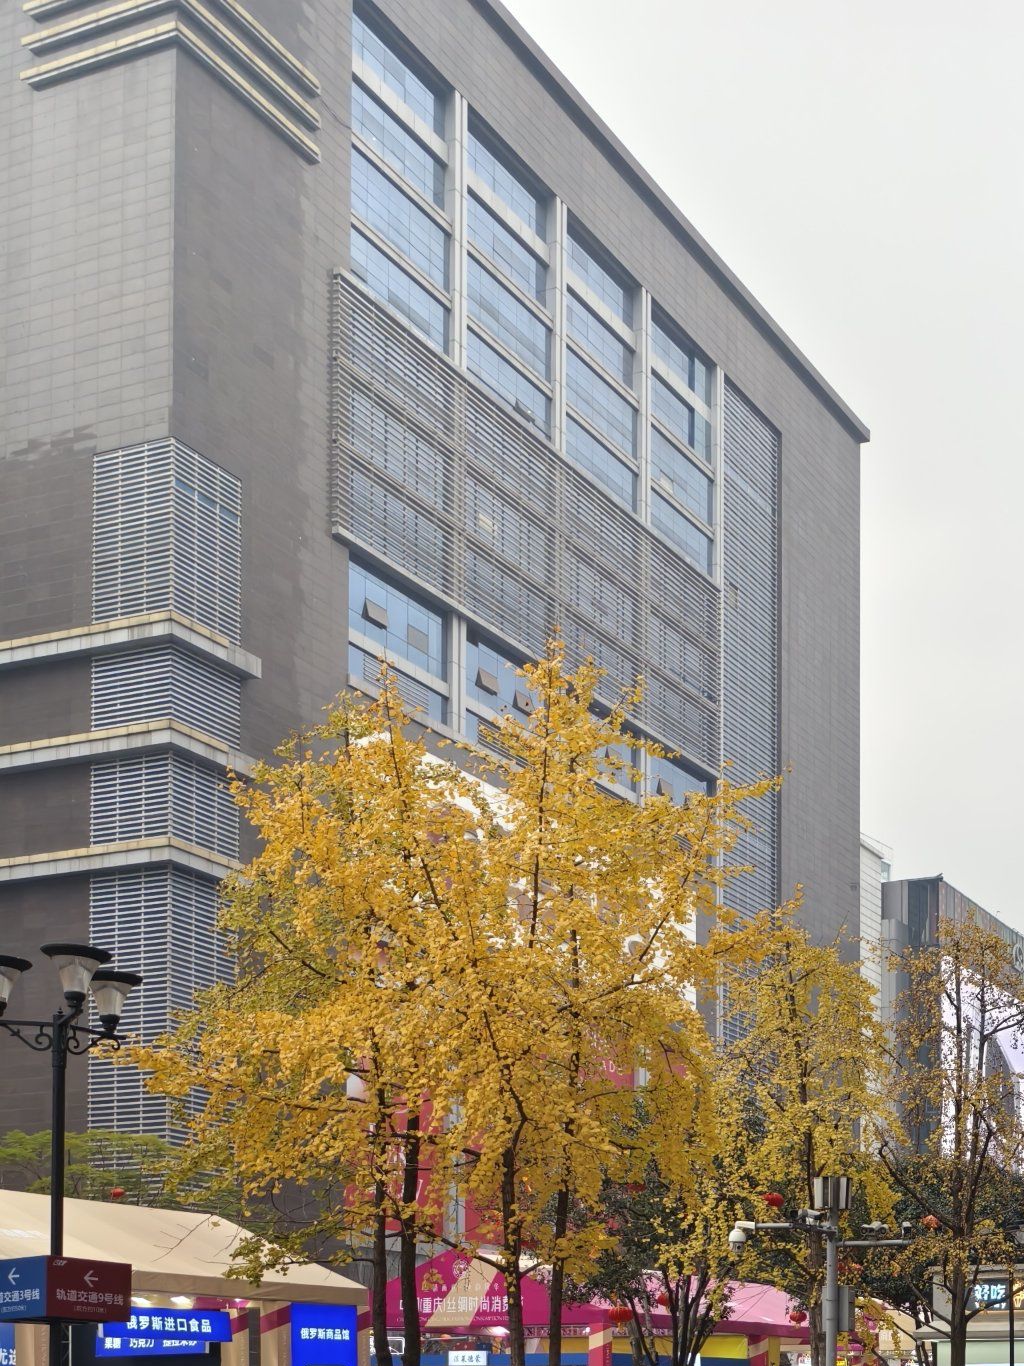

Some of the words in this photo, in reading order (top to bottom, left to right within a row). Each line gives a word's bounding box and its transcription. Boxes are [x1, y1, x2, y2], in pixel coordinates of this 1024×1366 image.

[0, 1288, 40, 1304] 交通3号线
[56, 1289, 124, 1306] 轨道交通9号线
[127, 1315, 212, 1333] 俄罗斯进口食品
[300, 1328, 350, 1340] 俄罗斯商品馆
